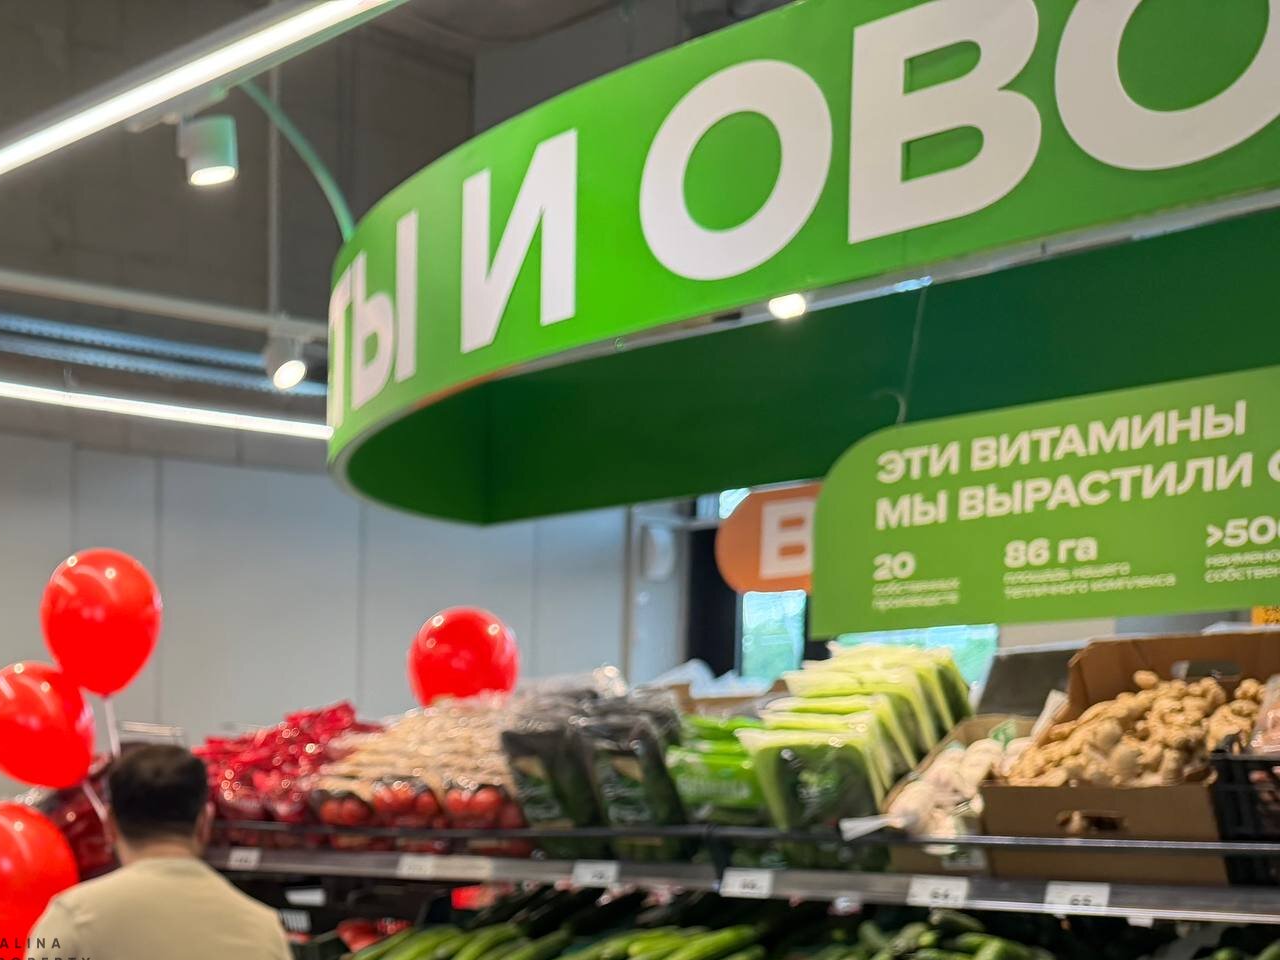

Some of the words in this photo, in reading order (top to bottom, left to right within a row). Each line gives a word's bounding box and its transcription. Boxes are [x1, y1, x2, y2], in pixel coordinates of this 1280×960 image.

[461, 128, 578, 354] И
[639, 0, 1280, 281] ОВО
[876, 441, 960, 484] ЭТИ
[971, 399, 1247, 472] ВИТАМИНЫ
[875, 490, 948, 530] МЫ
[958, 452, 1253, 521] ВЫРАСТИЛИ
[871, 550, 917, 582] 20
[1004, 537, 1051, 569] 86
[1057, 536, 1098, 563] га
[1090, 572, 1177, 593] комплекса
